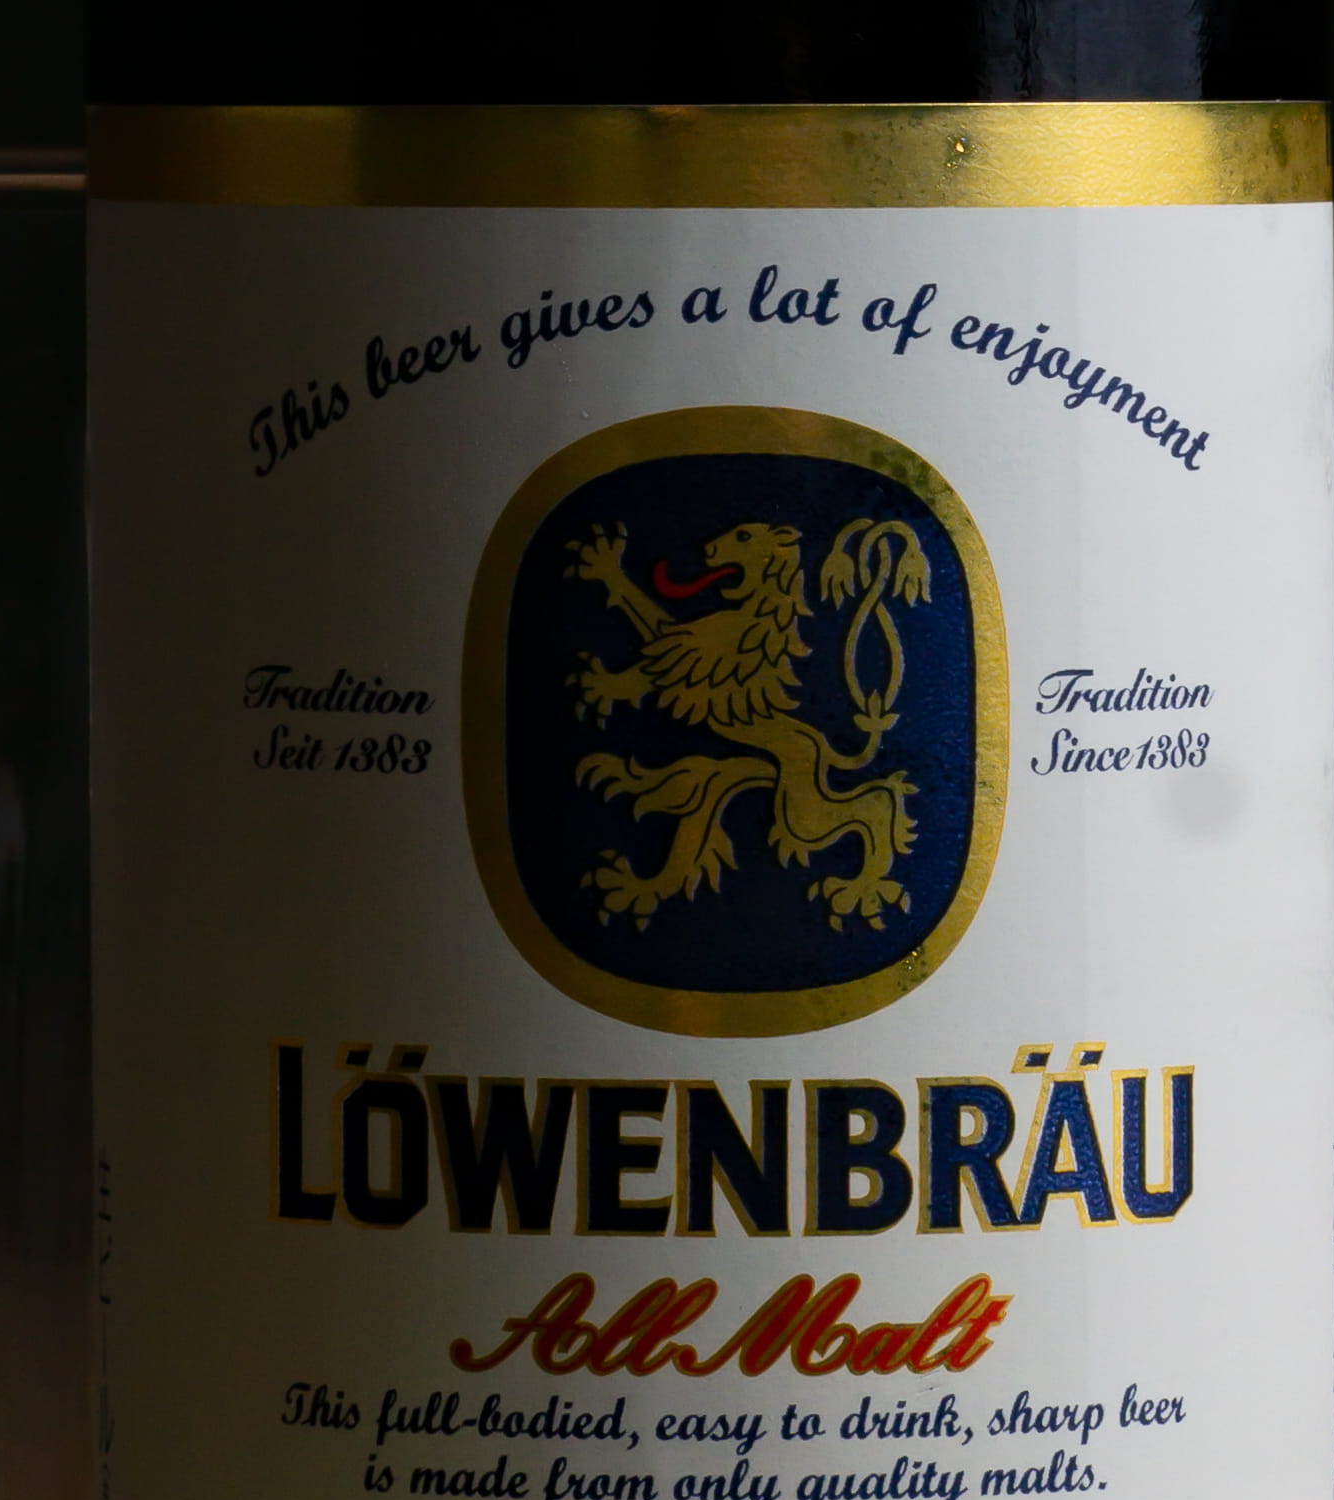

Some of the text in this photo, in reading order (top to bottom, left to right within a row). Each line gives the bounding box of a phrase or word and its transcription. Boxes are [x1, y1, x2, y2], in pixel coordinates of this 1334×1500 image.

[249, 265, 1209, 477] This beer gives a lot of enjoyment
[243, 664, 435, 716] Tradition
[1036, 668, 1214, 714] Tradition
[253, 724, 433, 774] Seit 1383
[1031, 727, 1209, 775] Since 1383
[273, 1041, 1195, 1236] LÖWENBRÄU
[450, 1271, 1013, 1376] All Malt
[281, 1382, 1186, 1455] This full-bodied, easy to drink, sharp beer
[364, 1452, 394, 1493] is
[410, 1453, 530, 1499] made
[981, 1449, 1107, 1495] malts.
